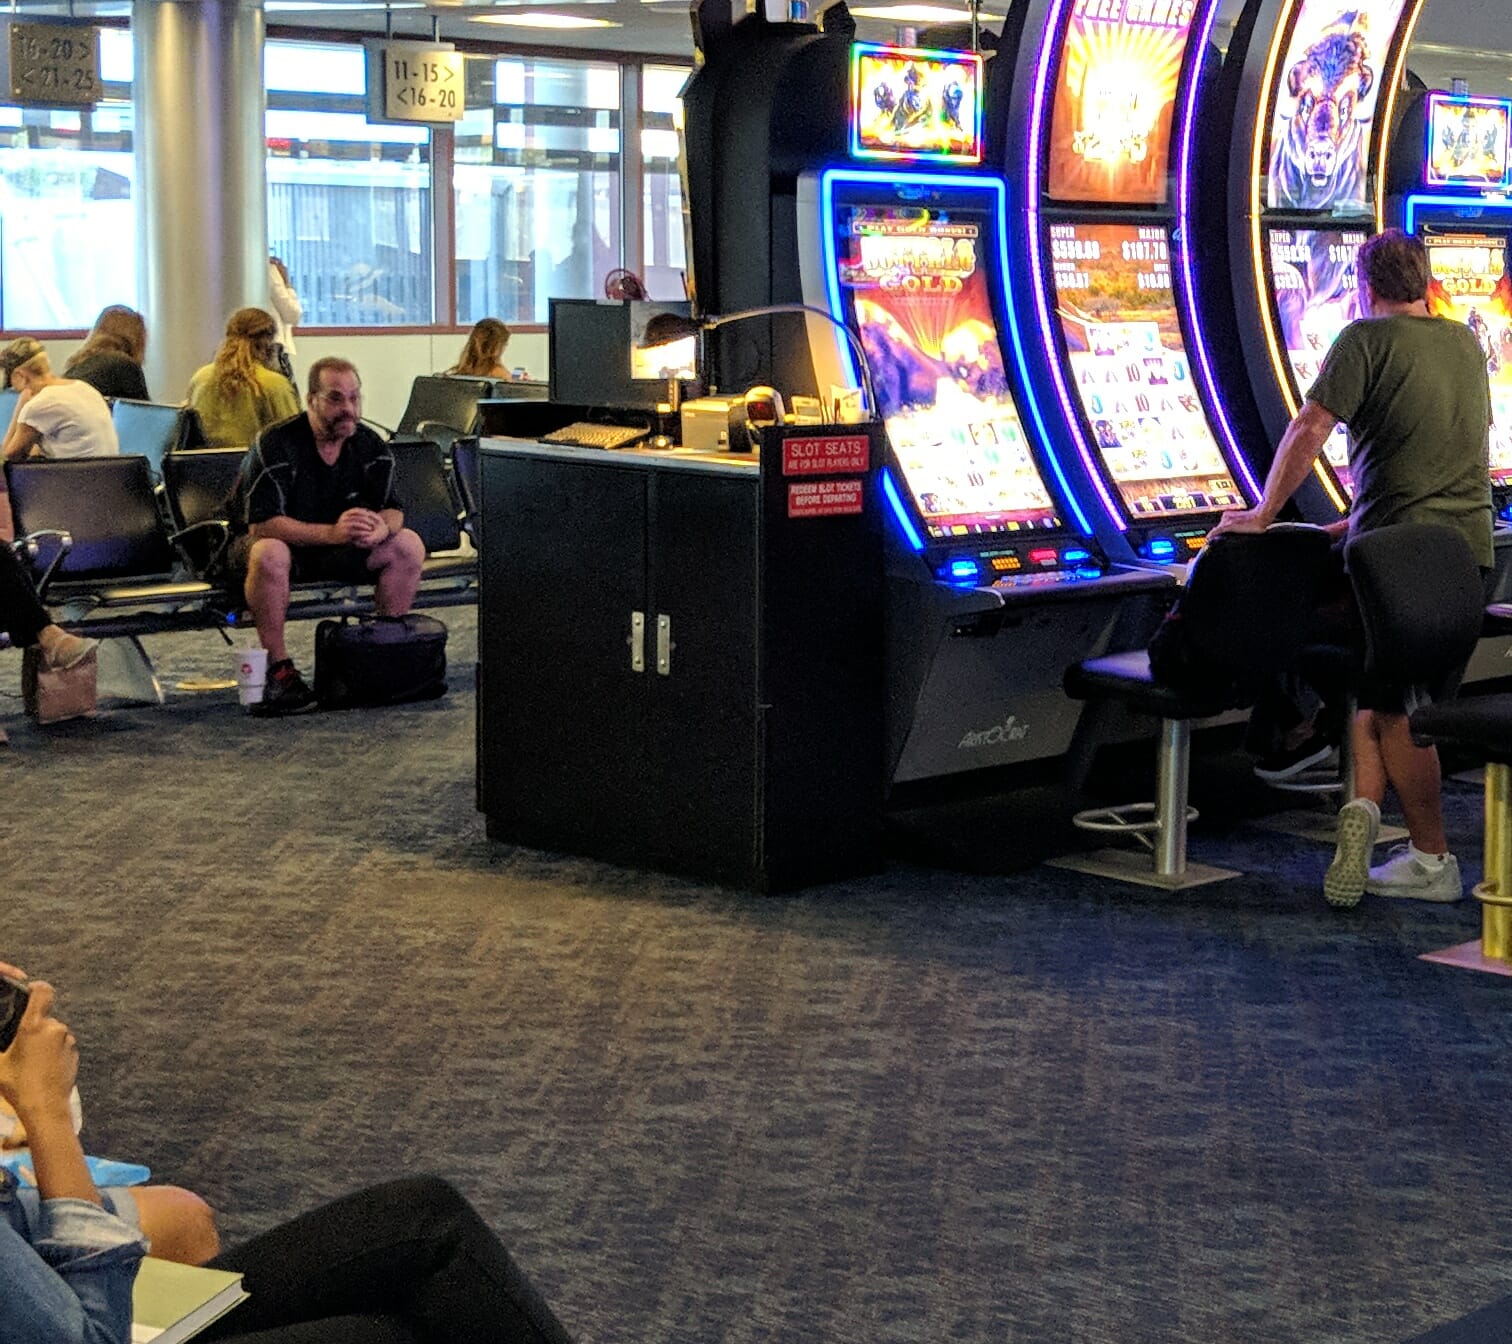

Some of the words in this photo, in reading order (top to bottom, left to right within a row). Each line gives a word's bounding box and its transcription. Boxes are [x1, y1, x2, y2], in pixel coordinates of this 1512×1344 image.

[880, 274, 963, 293] GOLD
[1442, 278, 1496, 295] GOLD
[790, 442, 820, 457] SLOT
[825, 441, 861, 456] SEATS
